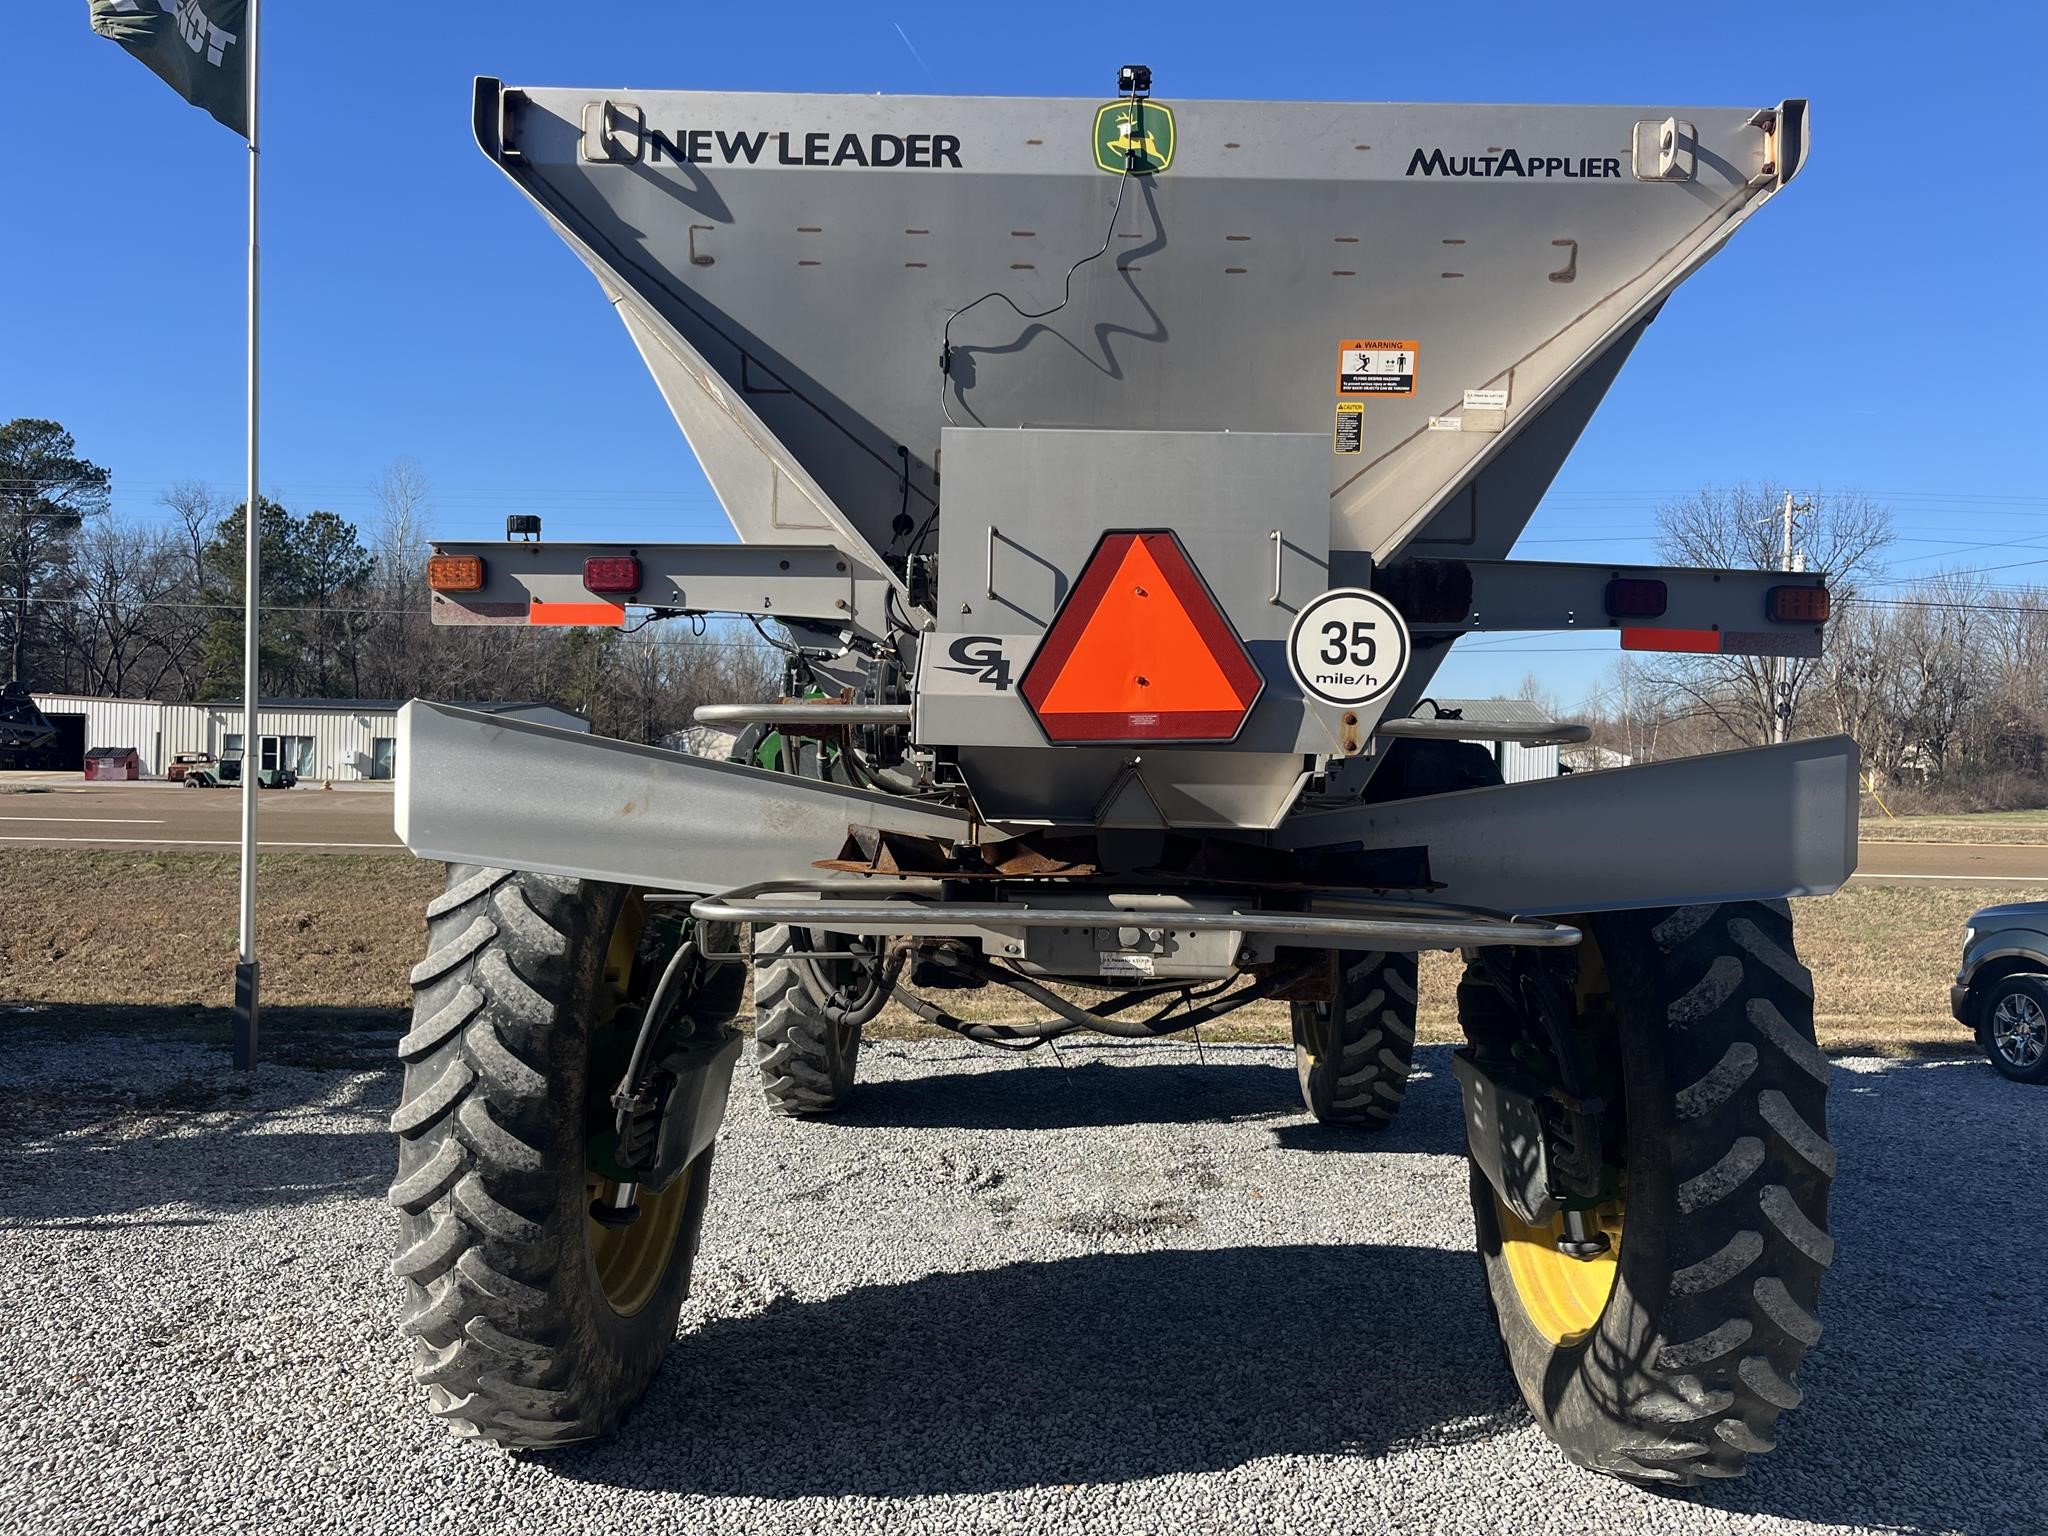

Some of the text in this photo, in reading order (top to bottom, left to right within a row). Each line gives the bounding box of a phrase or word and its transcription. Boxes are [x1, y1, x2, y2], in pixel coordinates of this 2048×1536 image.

[651, 130, 963, 168] NEW LEADER
[1406, 148, 1621, 178] MULTAPPLIER
[1320, 621, 1376, 667] 35
[948, 636, 1014, 691] G4
[1316, 673, 1377, 686] mile/h
